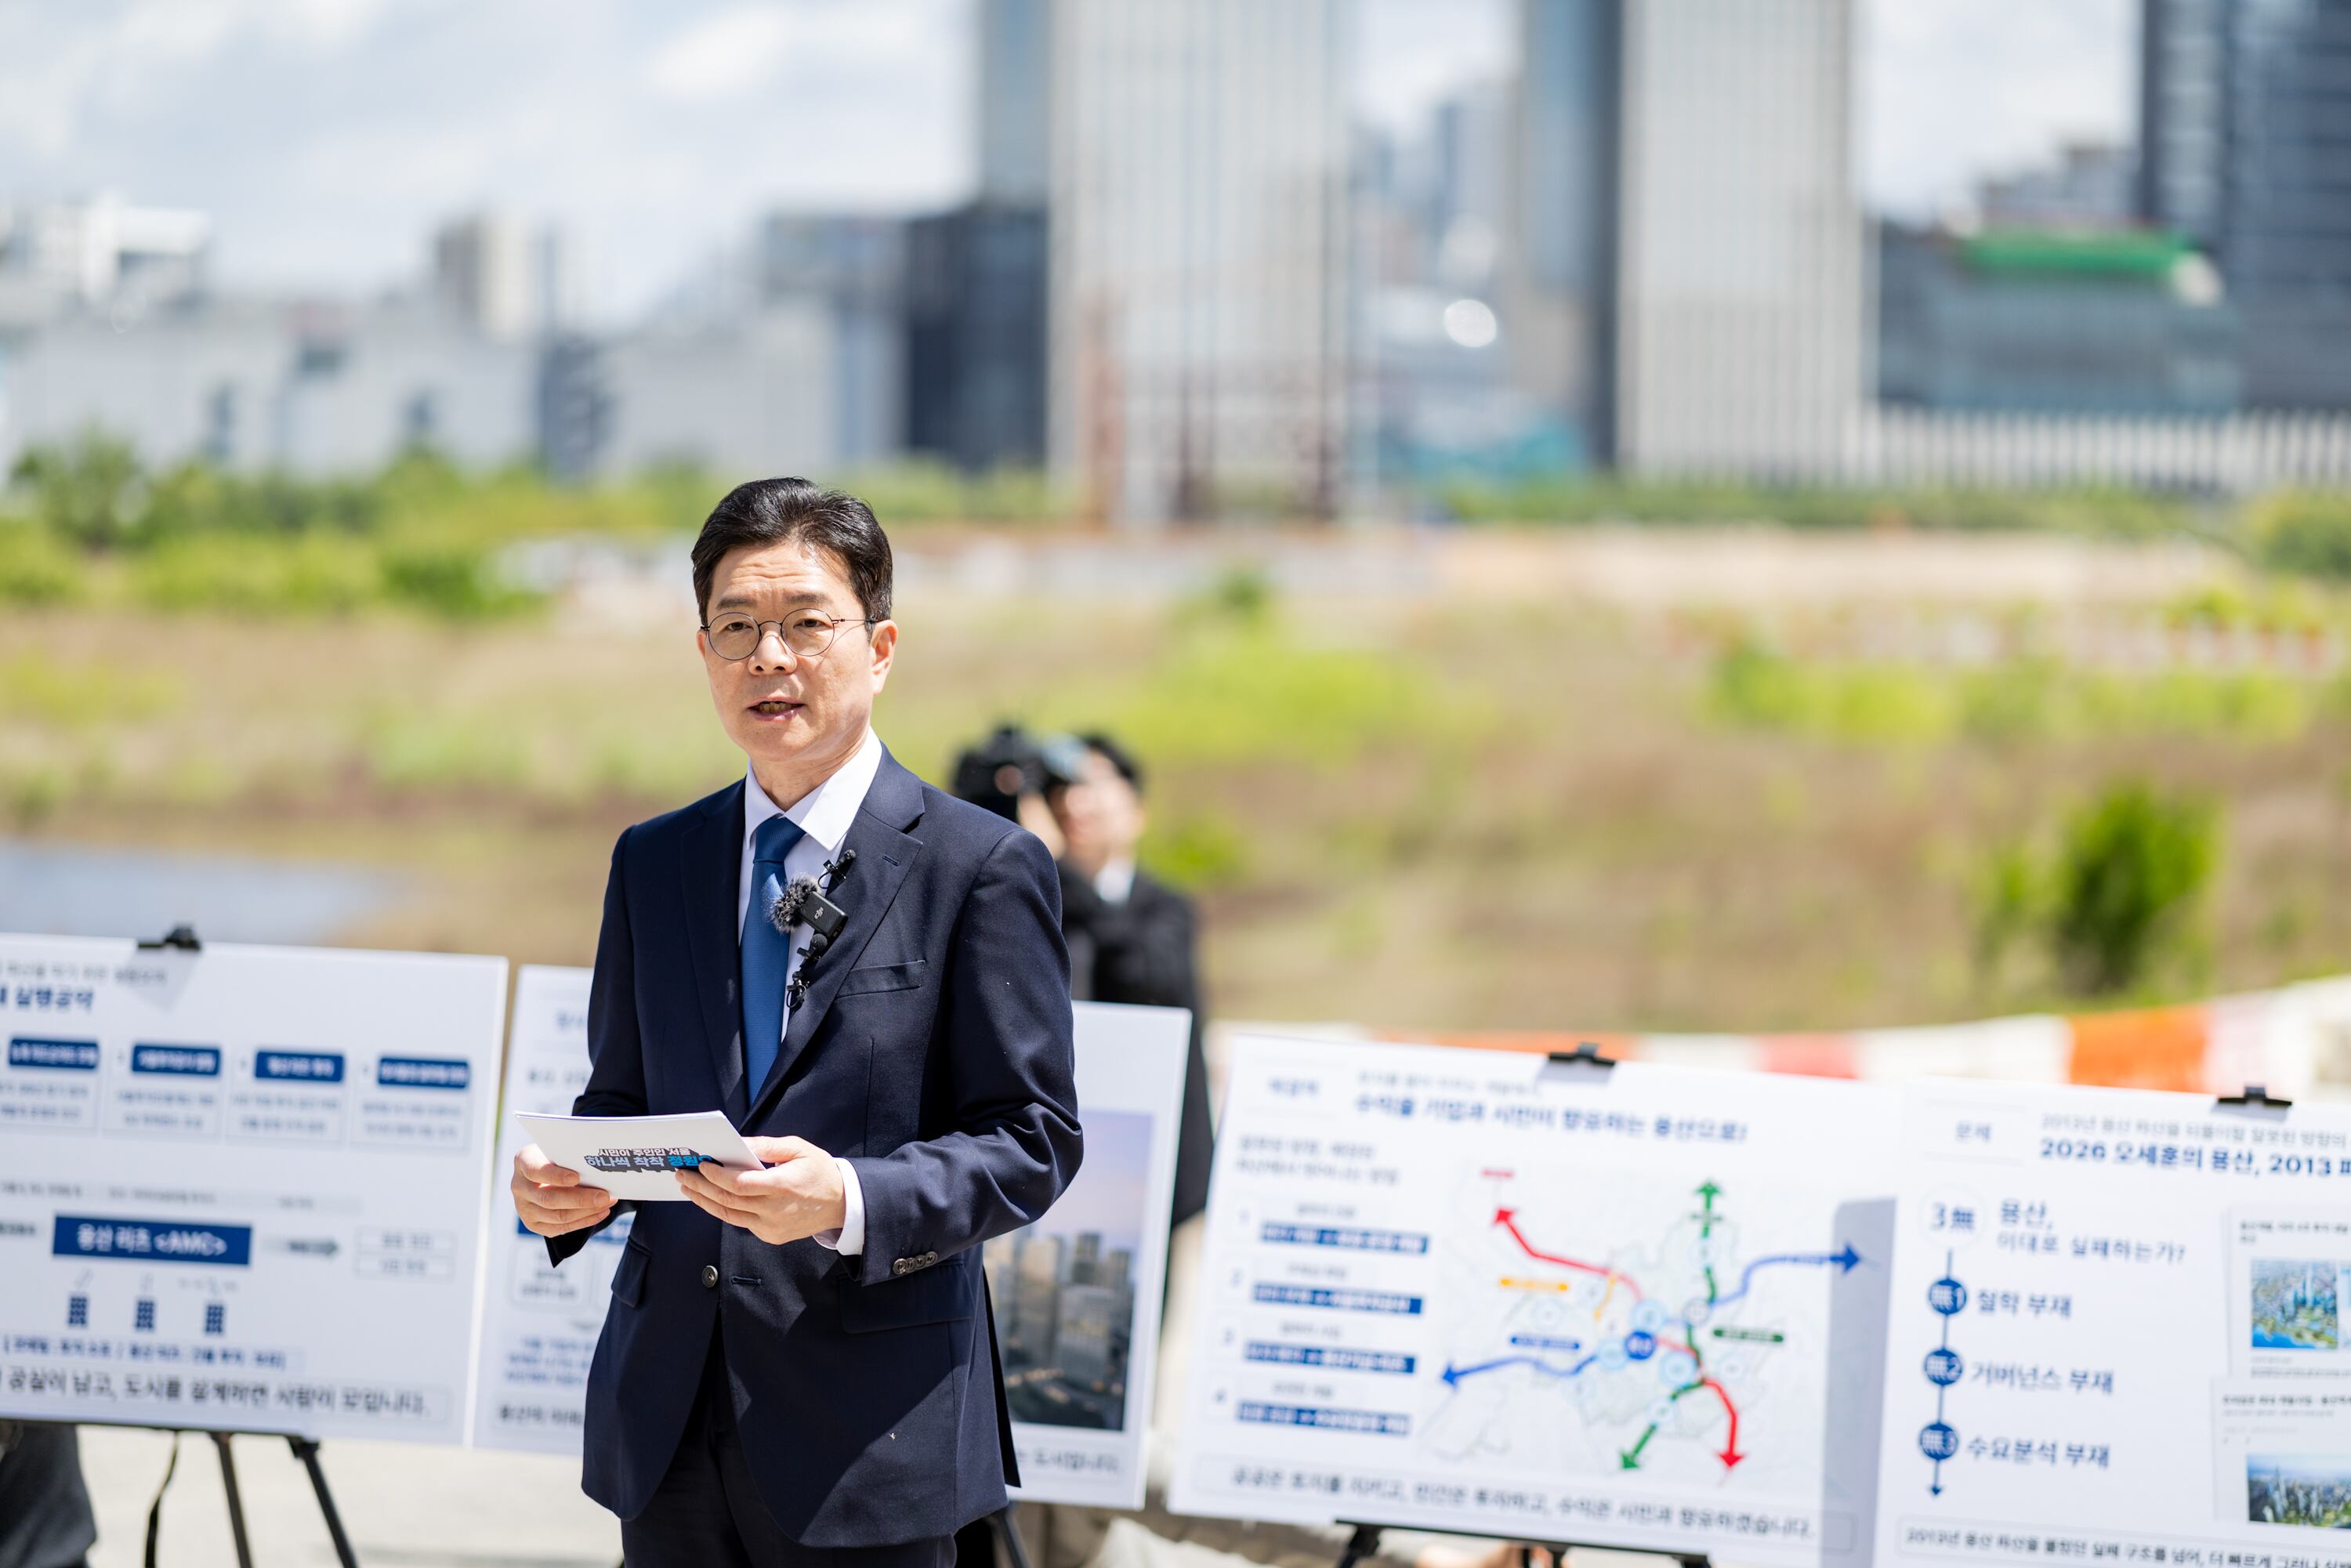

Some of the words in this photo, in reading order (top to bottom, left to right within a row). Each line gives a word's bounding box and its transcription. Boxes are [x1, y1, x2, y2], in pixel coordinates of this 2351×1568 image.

[1356, 1092, 1415, 1117] 수익을
[1425, 1098, 1486, 1122] 기업과
[1494, 1103, 1553, 1128] 시민이
[1563, 1107, 1645, 1135] 향유하는
[1956, 1121, 1991, 1142] 문제
[585, 1156, 631, 1168] 하나씩
[633, 1156, 665, 1167] 착착
[598, 1148, 631, 1157] 시민이
[632, 1147, 666, 1157] 주인인
[667, 1147, 690, 1156] 서울
[2041, 1140, 2106, 1161] 2026
[2114, 1142, 2203, 1170] 오세훈의
[2212, 1146, 2259, 1177] 용산,
[2269, 1153, 2331, 1176] 2013
[2000, 1200, 2054, 1231] 용산,
[78, 1223, 112, 1251] 용산
[114, 1226, 151, 1254] 리츠
[154, 1229, 227, 1257] <AMC>
[1998, 1232, 2060, 1255] 이대로
[2070, 1235, 2186, 1266] 실패하는가?
[1977, 1288, 2020, 1316] 철학
[2027, 1291, 2074, 1319] 부재
[9, 1367, 66, 1396] 공실이
[74, 1371, 117, 1402] 남고,
[124, 1374, 182, 1403] 도시를
[191, 1379, 271, 1409] 설계하면
[277, 1383, 335, 1410] 사람이
[342, 1387, 430, 1418] 모입니다.
[1972, 1360, 2061, 1390] 거버넌스
[2069, 1367, 2114, 1394] 부재
[1967, 1436, 2058, 1467] 수요분석
[2064, 1443, 2111, 1470] 부재
[1619, 1500, 1672, 1526] 시민과
[1679, 1505, 1817, 1538] 향유하겠습니다.
